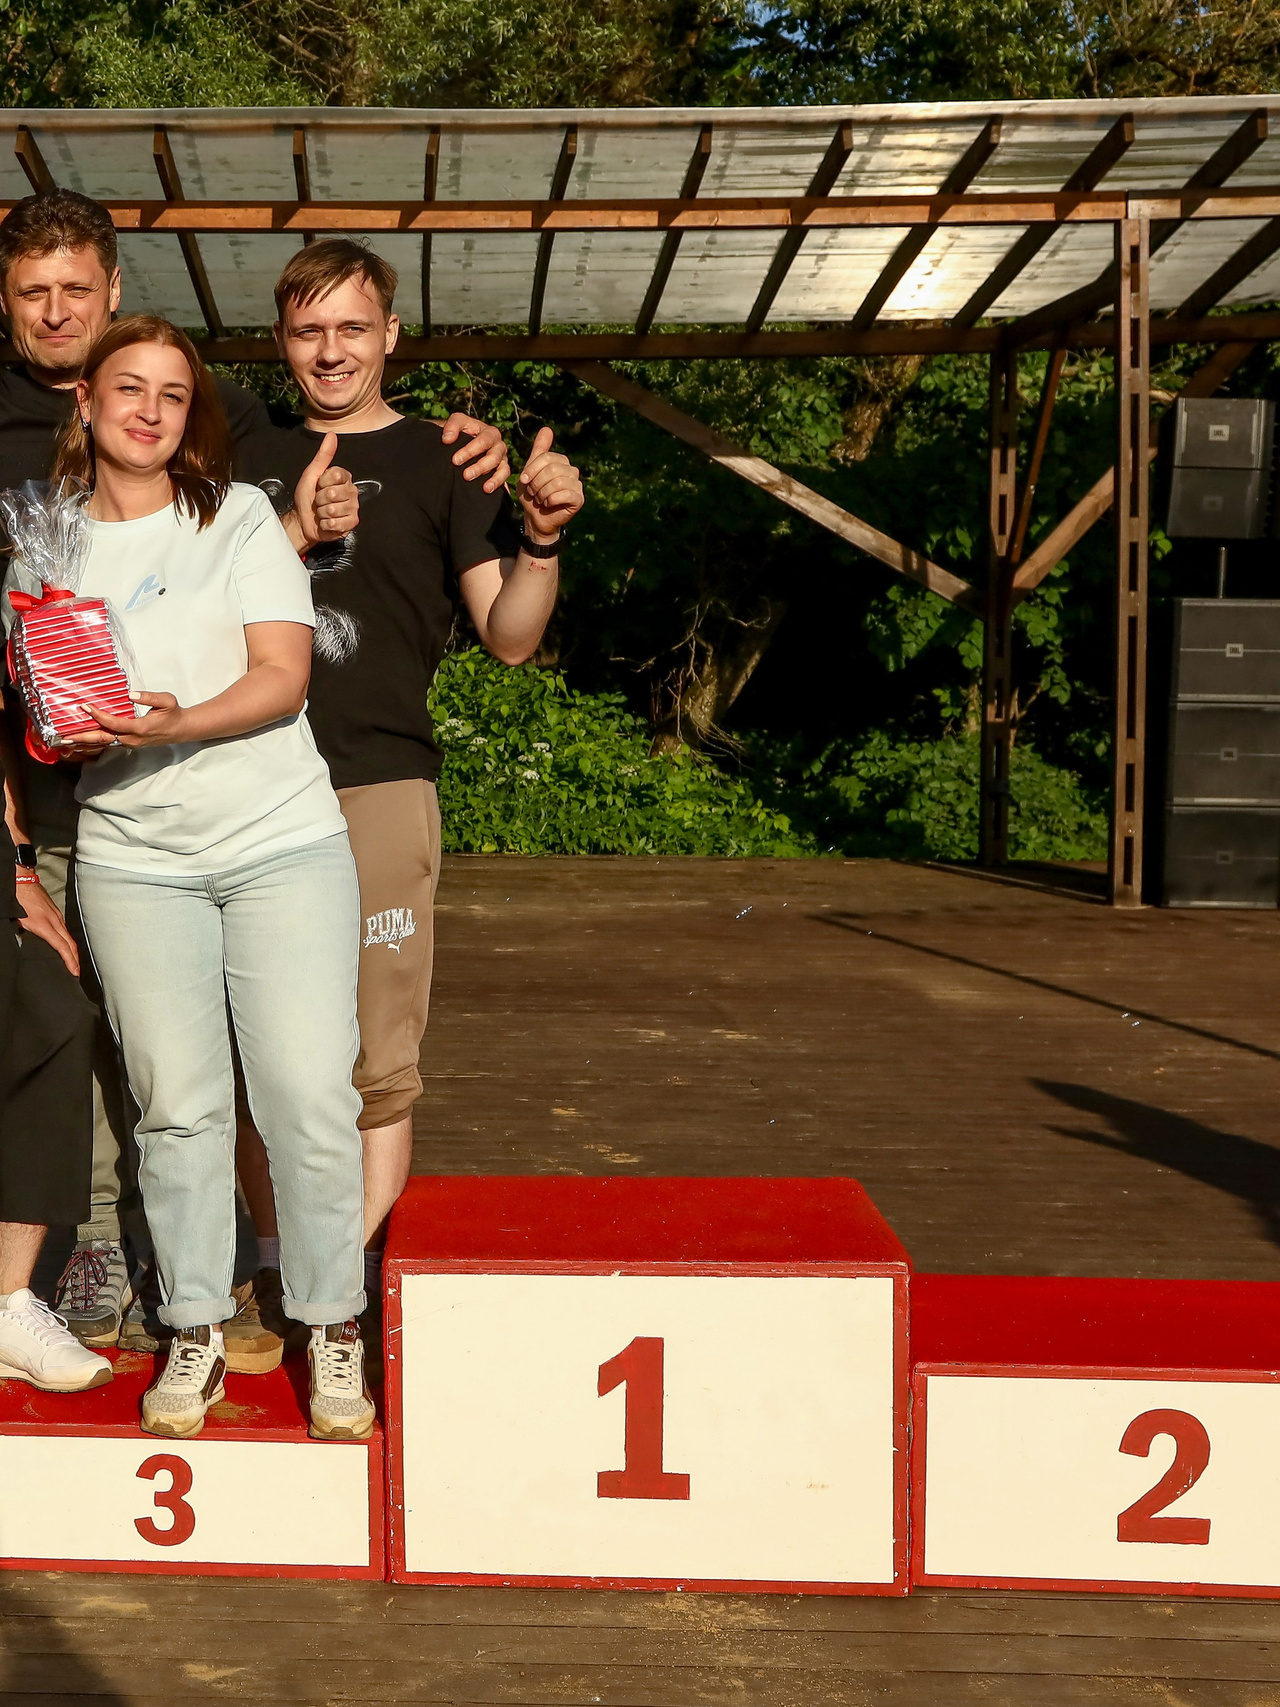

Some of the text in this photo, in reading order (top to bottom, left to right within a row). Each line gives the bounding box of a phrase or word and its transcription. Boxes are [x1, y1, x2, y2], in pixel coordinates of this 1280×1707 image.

[363, 930, 399, 948] sports
[366, 908, 413, 936] PUMA
[597, 1336, 691, 1501] 1
[134, 1454, 196, 1547] 3
[1117, 1409, 1211, 1545] 2
